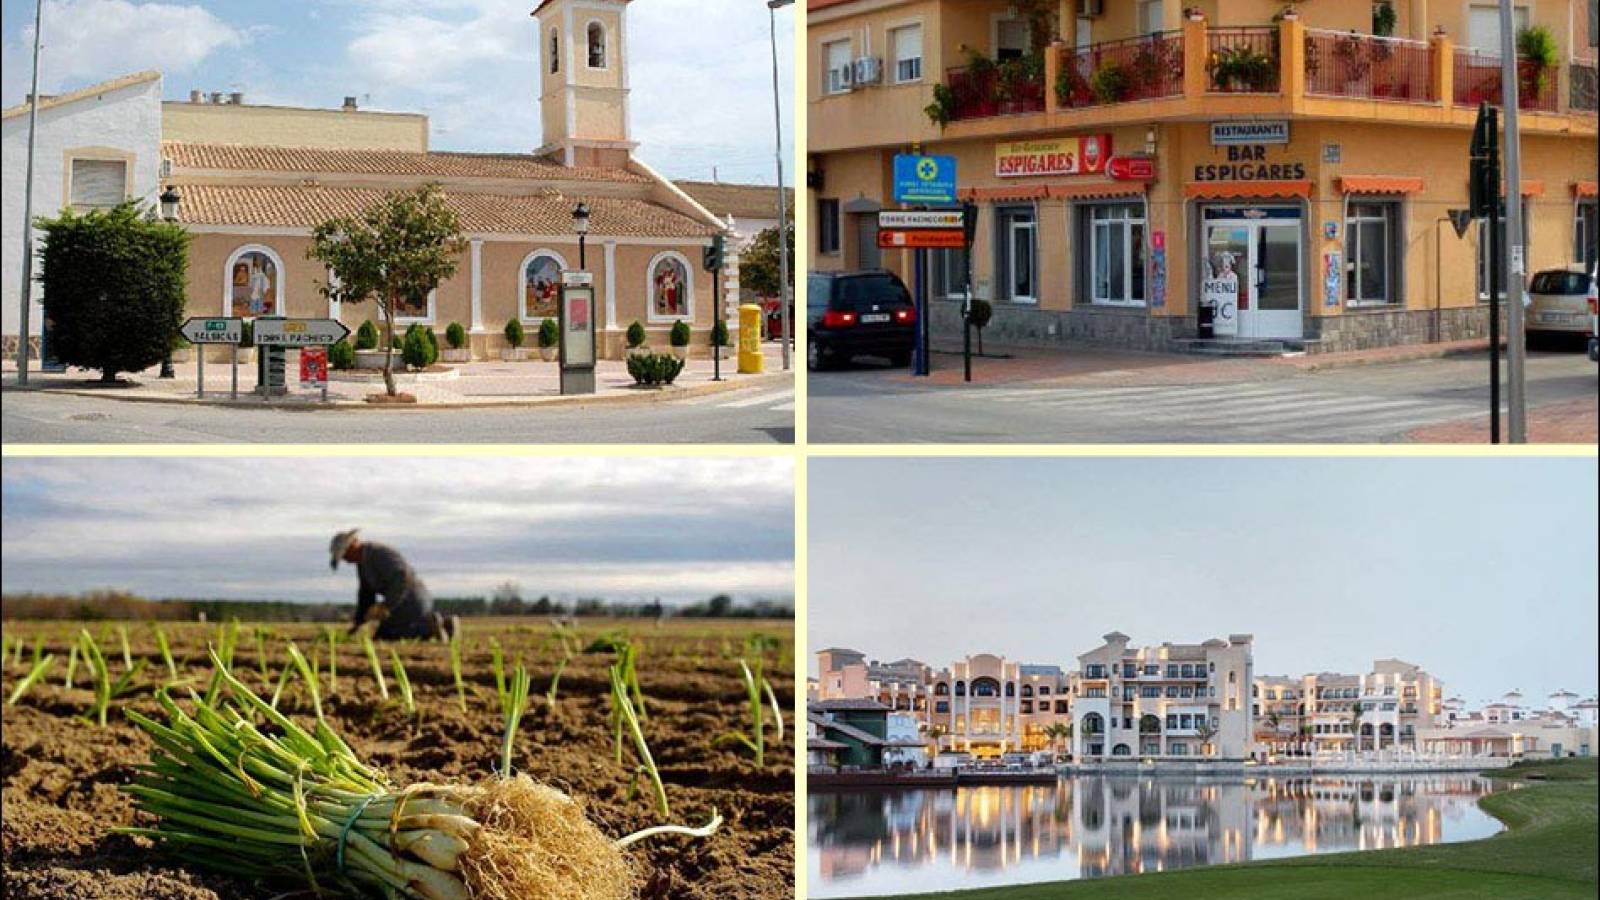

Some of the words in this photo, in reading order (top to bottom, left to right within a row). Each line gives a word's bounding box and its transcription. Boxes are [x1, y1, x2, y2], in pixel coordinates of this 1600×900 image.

[1214, 124, 1284, 137] RESTAURANTE
[1228, 145, 1265, 161] BAR
[1000, 152, 1074, 173] ESPIGARES
[1194, 162, 1306, 181] ESPIGARES
[880, 215, 906, 225] TORRE
